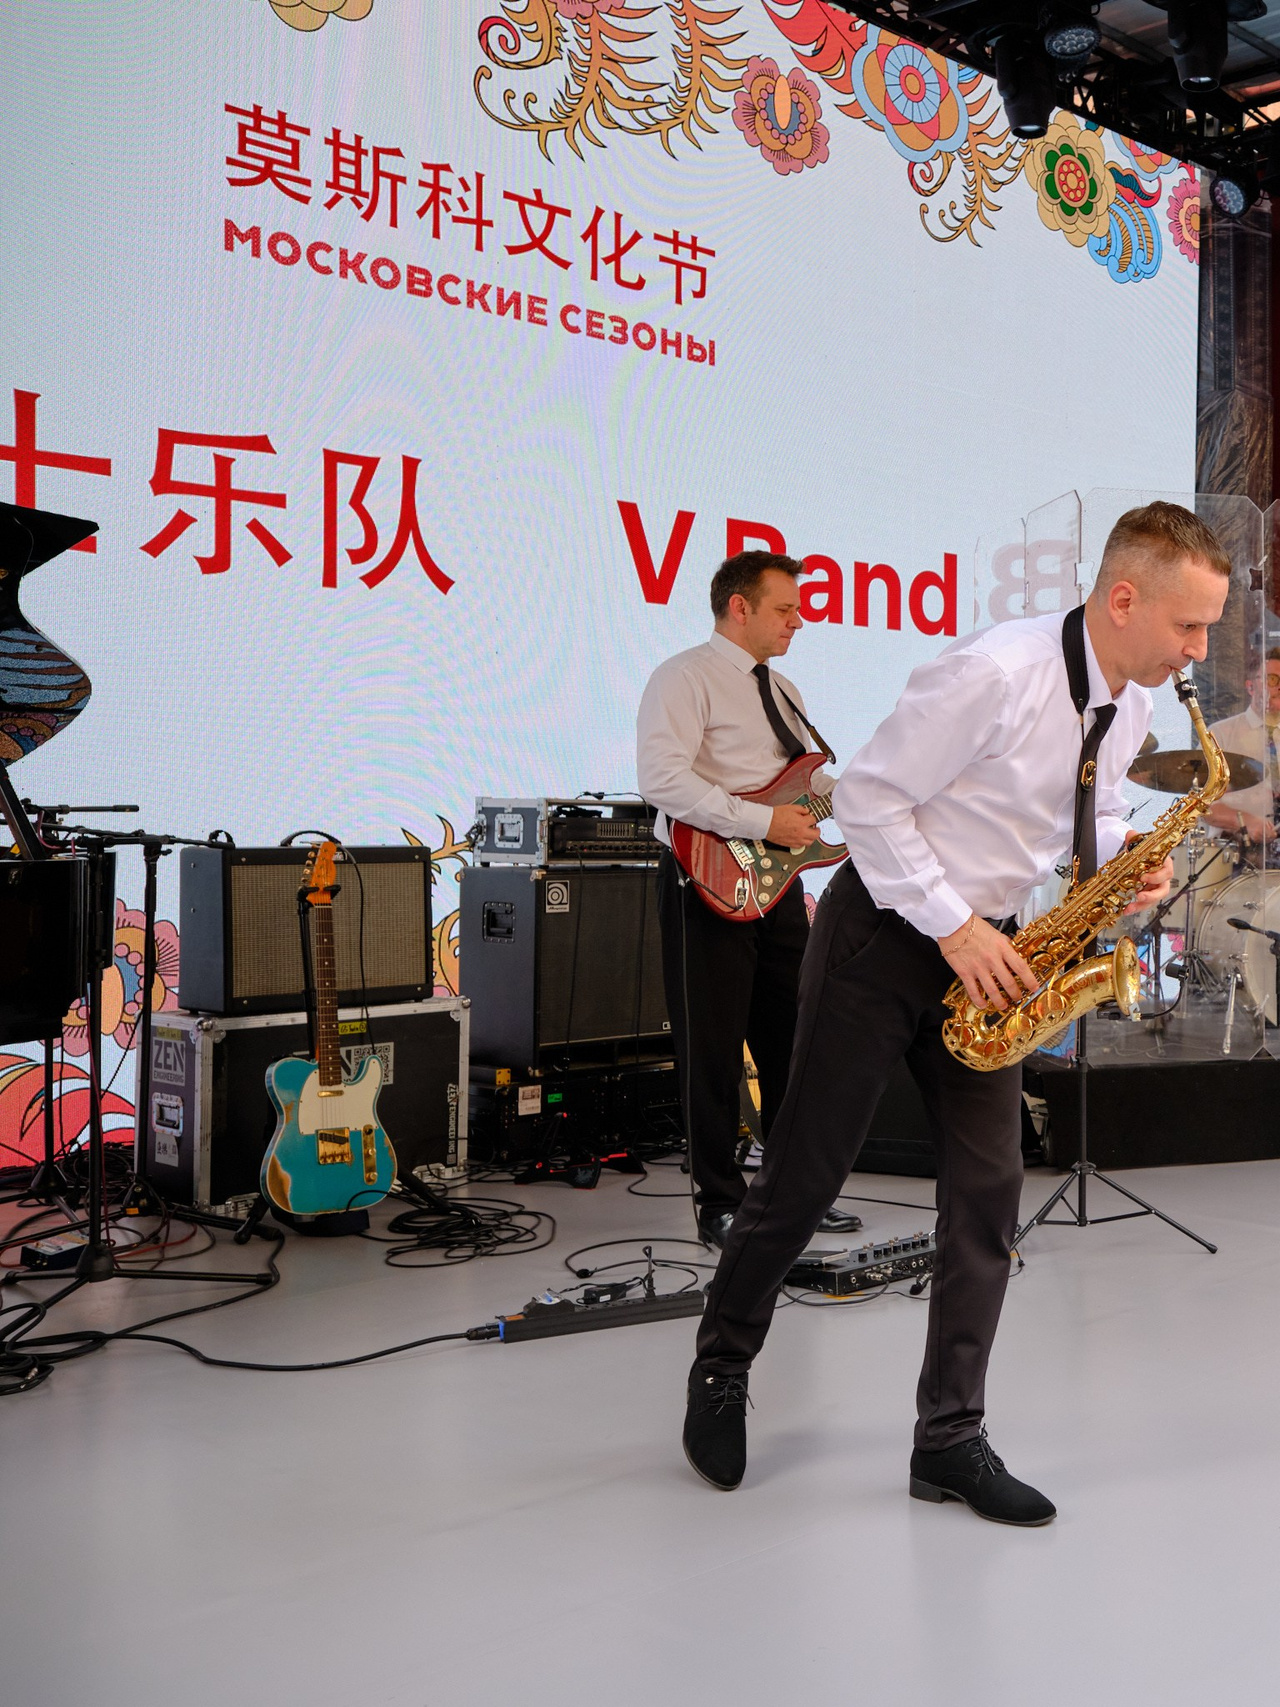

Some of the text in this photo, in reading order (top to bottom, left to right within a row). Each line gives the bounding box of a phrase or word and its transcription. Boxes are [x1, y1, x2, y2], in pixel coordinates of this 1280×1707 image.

[223, 103, 716, 306] 莫斯科文化节
[223, 218, 716, 367] МОСКОВСКИЕ СЕЗОНЫ
[616, 500, 696, 605] V
[154, 1039, 184, 1073] ZEN
